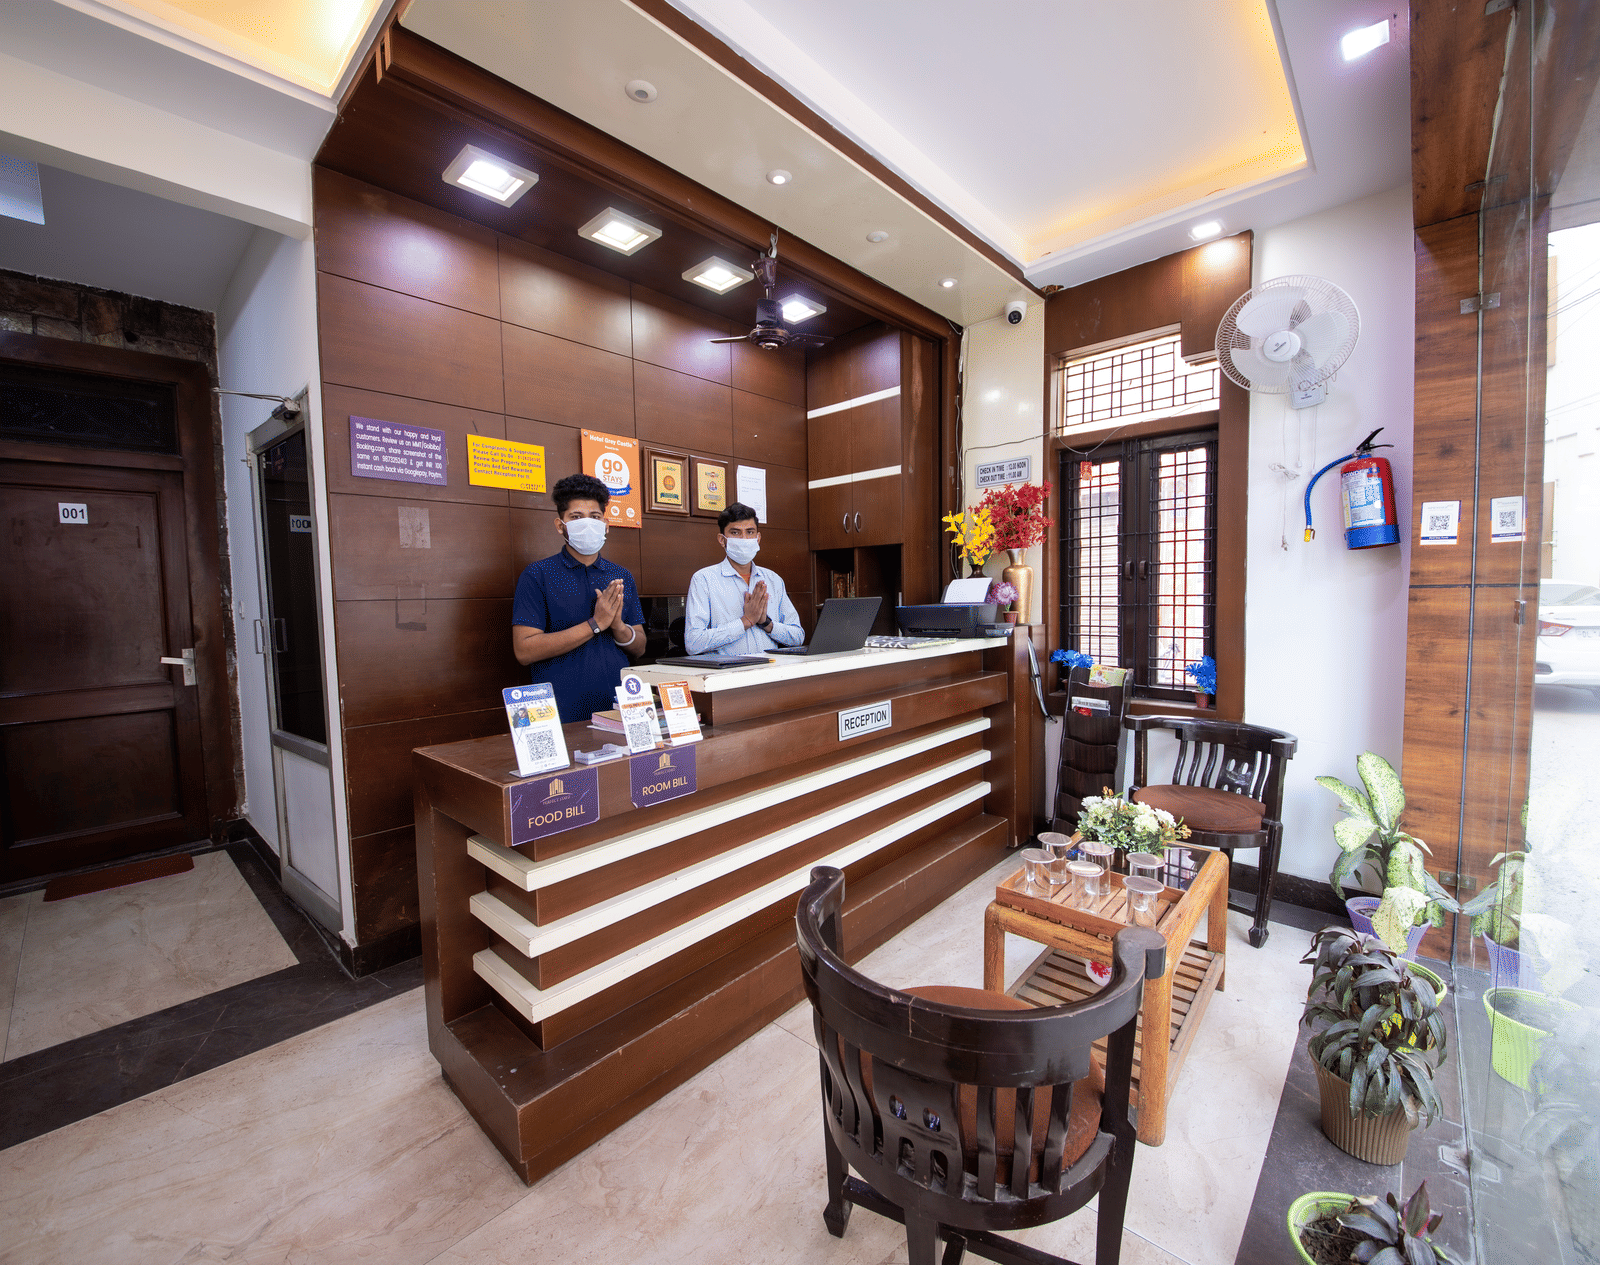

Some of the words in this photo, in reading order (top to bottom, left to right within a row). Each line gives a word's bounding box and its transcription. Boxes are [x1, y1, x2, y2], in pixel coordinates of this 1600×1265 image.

[404, 430, 418, 439] happy
[431, 434, 441, 442] loyal
[590, 434, 604, 442] Hotel
[605, 438, 616, 446] Grey
[617, 440, 633, 448] Castle
[482, 443, 507, 451] Complaints
[403, 450, 426, 458] screenshot
[357, 462, 372, 470] instant
[602, 459, 623, 474] go
[603, 475, 623, 483] STAYS
[62, 508, 85, 520] 001
[523, 688, 548, 697] PhonePe
[844, 710, 886, 731] RECEPTION
[642, 779, 671, 797] ROOM
[672, 776, 688, 789] BILL
[528, 810, 562, 829] FOOD
[565, 805, 585, 819] BILL
